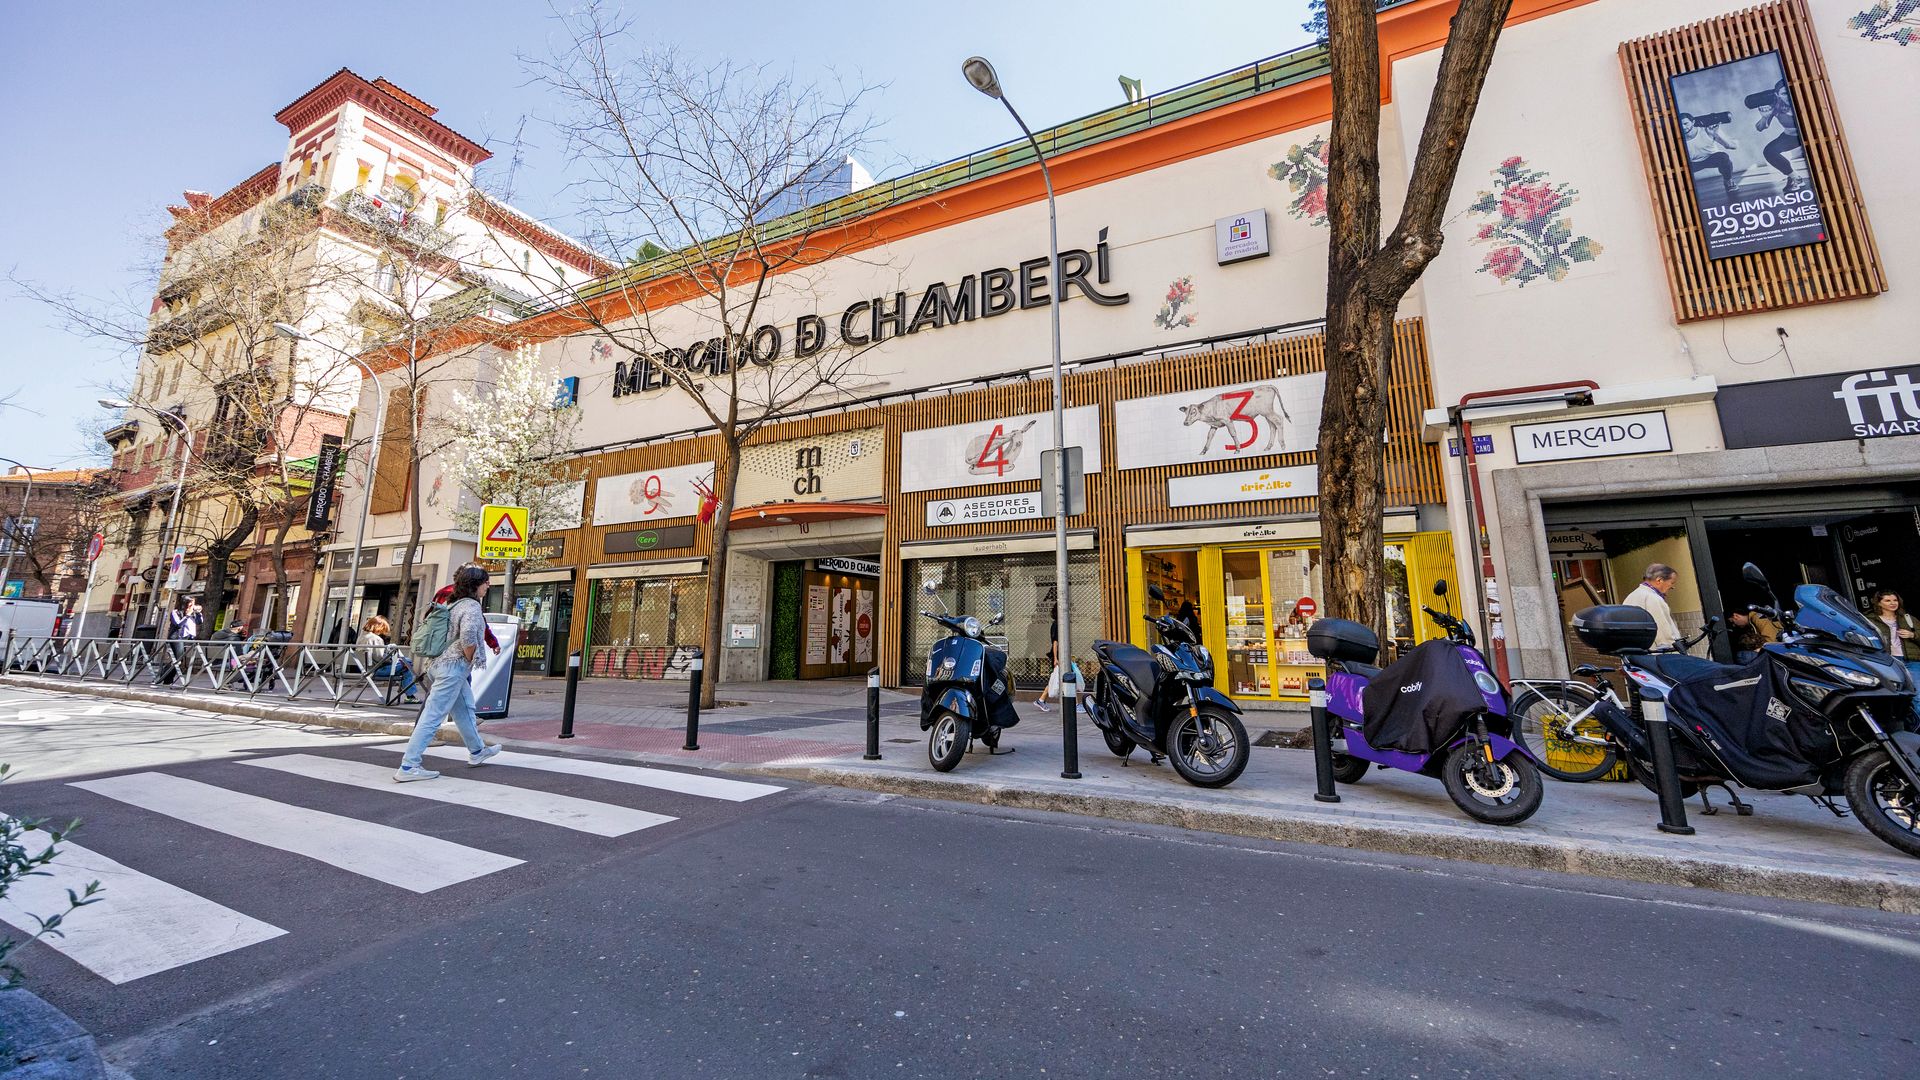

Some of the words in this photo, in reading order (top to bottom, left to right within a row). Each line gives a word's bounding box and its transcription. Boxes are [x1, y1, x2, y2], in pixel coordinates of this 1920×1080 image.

[1702, 206, 1726, 220] TU
[1729, 190, 1814, 216] GIMNASIO
[1708, 210, 1775, 238] 29,90
[1778, 204, 1819, 220] €/MES
[1790, 213, 1820, 224] INCLUIDO
[1224, 240, 1258, 250] mercados
[1234, 245, 1259, 255] madrid
[612, 324, 782, 398] MERCADO
[840, 226, 1130, 346] CHAMBERÍ
[1832, 370, 1920, 424] fit
[1222, 390, 1258, 450] 3
[1854, 420, 1920, 436] SMAR
[1532, 422, 1646, 448] MERCADO
[796, 445, 822, 470] m
[976, 424, 1009, 477] 4
[1476, 444, 1491, 453] CANO
[794, 468, 822, 496] ch
[315, 488, 328, 518] MERCADO
[963, 498, 1029, 510] ASESORES
[963, 506, 1036, 519] ASOCIADOS
[819, 558, 849, 571] MERCADO
[517, 644, 545, 659] SERVICE
[1400, 681, 1423, 693] cabify
